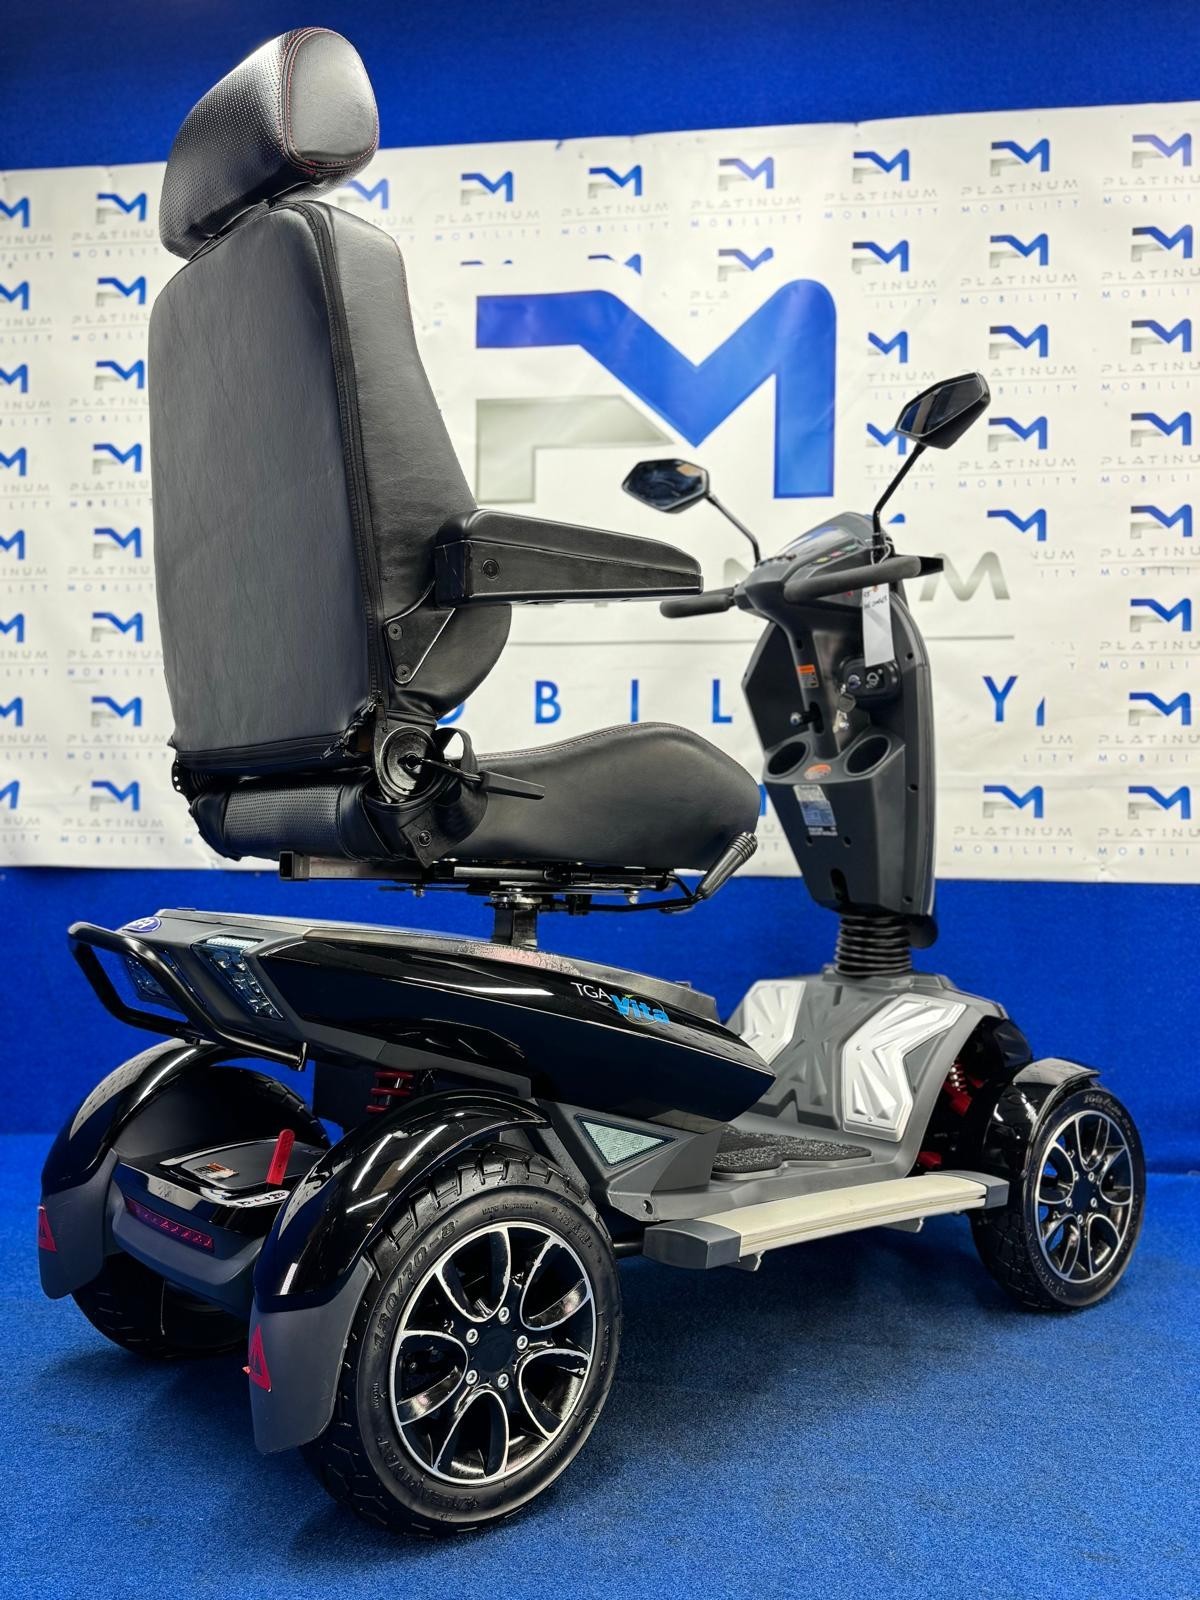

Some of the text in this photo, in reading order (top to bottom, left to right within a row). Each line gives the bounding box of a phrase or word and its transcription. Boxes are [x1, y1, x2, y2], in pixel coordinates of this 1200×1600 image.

[1103, 175, 1200, 187] PLATINU
[1104, 194, 1191, 204] MOBILI
[72, 230, 154, 241] PLATINU
[73, 248, 158, 259] MOBILIT
[1101, 268, 1200, 280] PLATINU
[1102, 288, 1190, 299] MOBILI
[72, 314, 149, 324] PLATIN
[72, 332, 144, 342] MOBILI
[1101, 362, 1200, 374] PLATINU
[1101, 380, 1190, 391] MOBILI
[70, 398, 149, 408] PLATIN
[69, 414, 143, 424] MOBILI
[1101, 453, 1200, 466] PLATINU
[1101, 474, 1190, 484] MOBILI
[69, 481, 149, 492] PLATINU
[1100, 546, 1200, 558] PLATINU
[67, 566, 151, 576] PLATINU
[1101, 566, 1190, 576] MOBILI
[1100, 640, 1200, 650] PLATINU
[1100, 660, 1189, 670] MOBILI
[67, 668, 155, 677] MOBILIT
[1098, 734, 1200, 744] PLATINU
[1098, 753, 1188, 763] MOBILI
[1098, 826, 1200, 838] PLATINU
[1098, 846, 1189, 857] MOBILI
[570, 981, 670, 1024] TGA Vita
